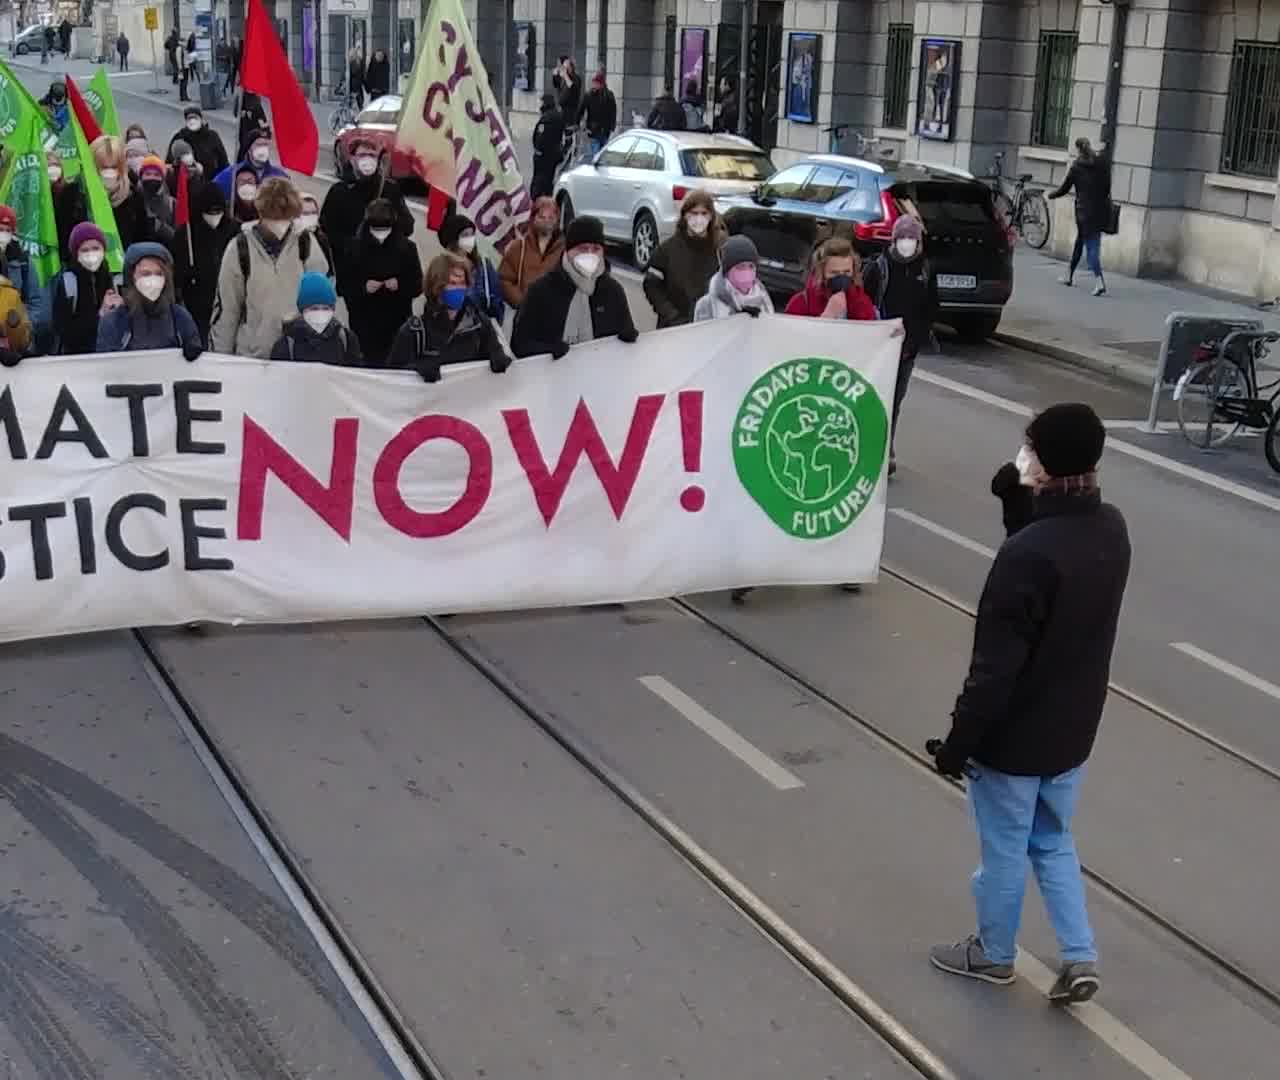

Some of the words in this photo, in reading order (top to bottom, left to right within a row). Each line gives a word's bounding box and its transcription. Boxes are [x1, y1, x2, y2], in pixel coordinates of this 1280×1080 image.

[738, 363, 810, 448] FRIDAYS
[818, 364, 866, 403] FOR
[237, 390, 705, 545] NOW!
[791, 475, 873, 535] FUTURE
